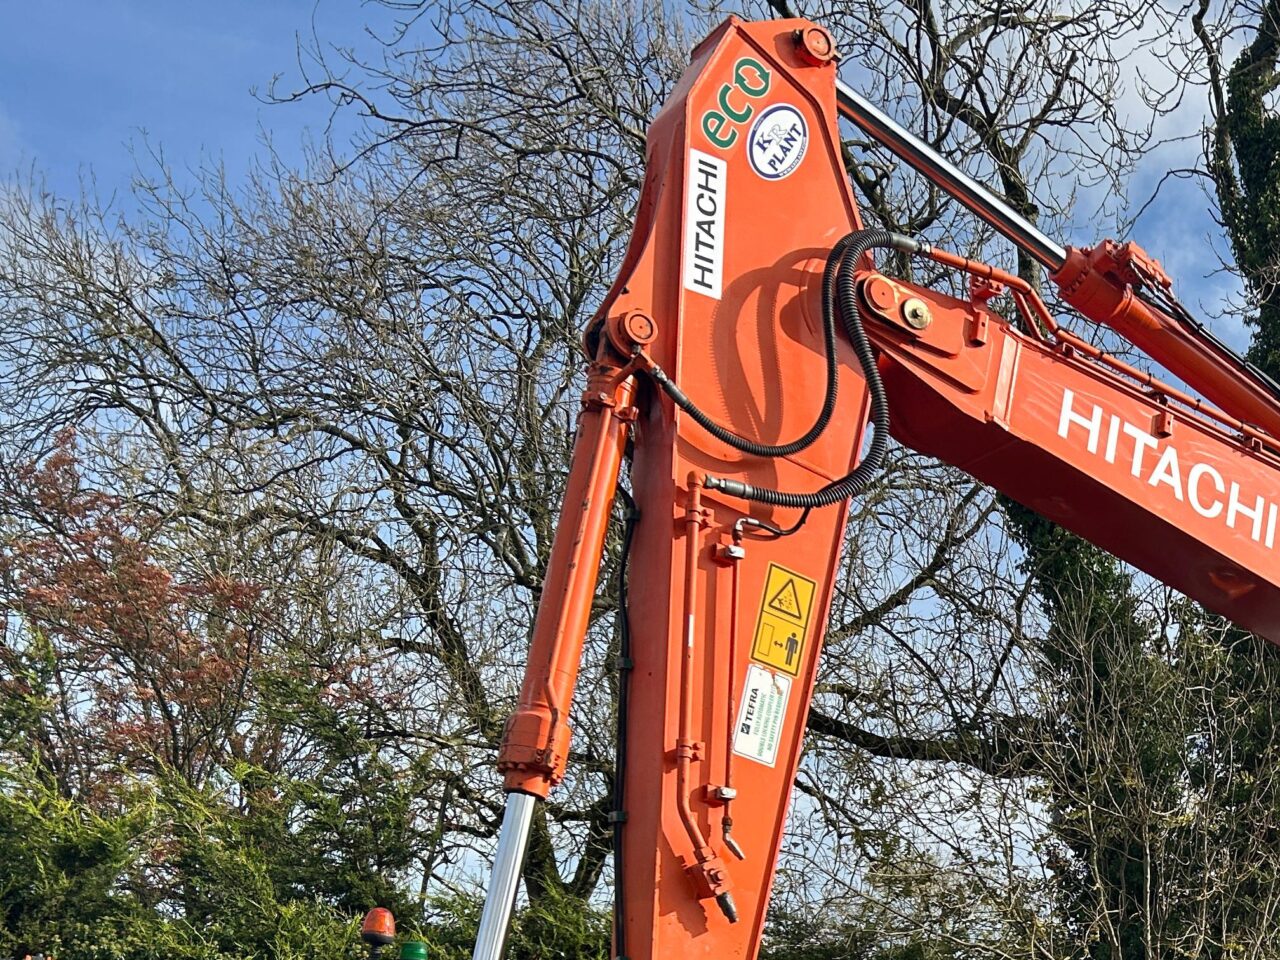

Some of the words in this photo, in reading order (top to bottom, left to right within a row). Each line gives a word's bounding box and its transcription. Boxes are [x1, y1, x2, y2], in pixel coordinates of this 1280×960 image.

[702, 57, 771, 149] eco
[767, 122, 802, 172] PLANT
[693, 159, 718, 289] HITACHI
[1057, 388, 1278, 549] HITACHI
[745, 687, 759, 721] TEFRA
